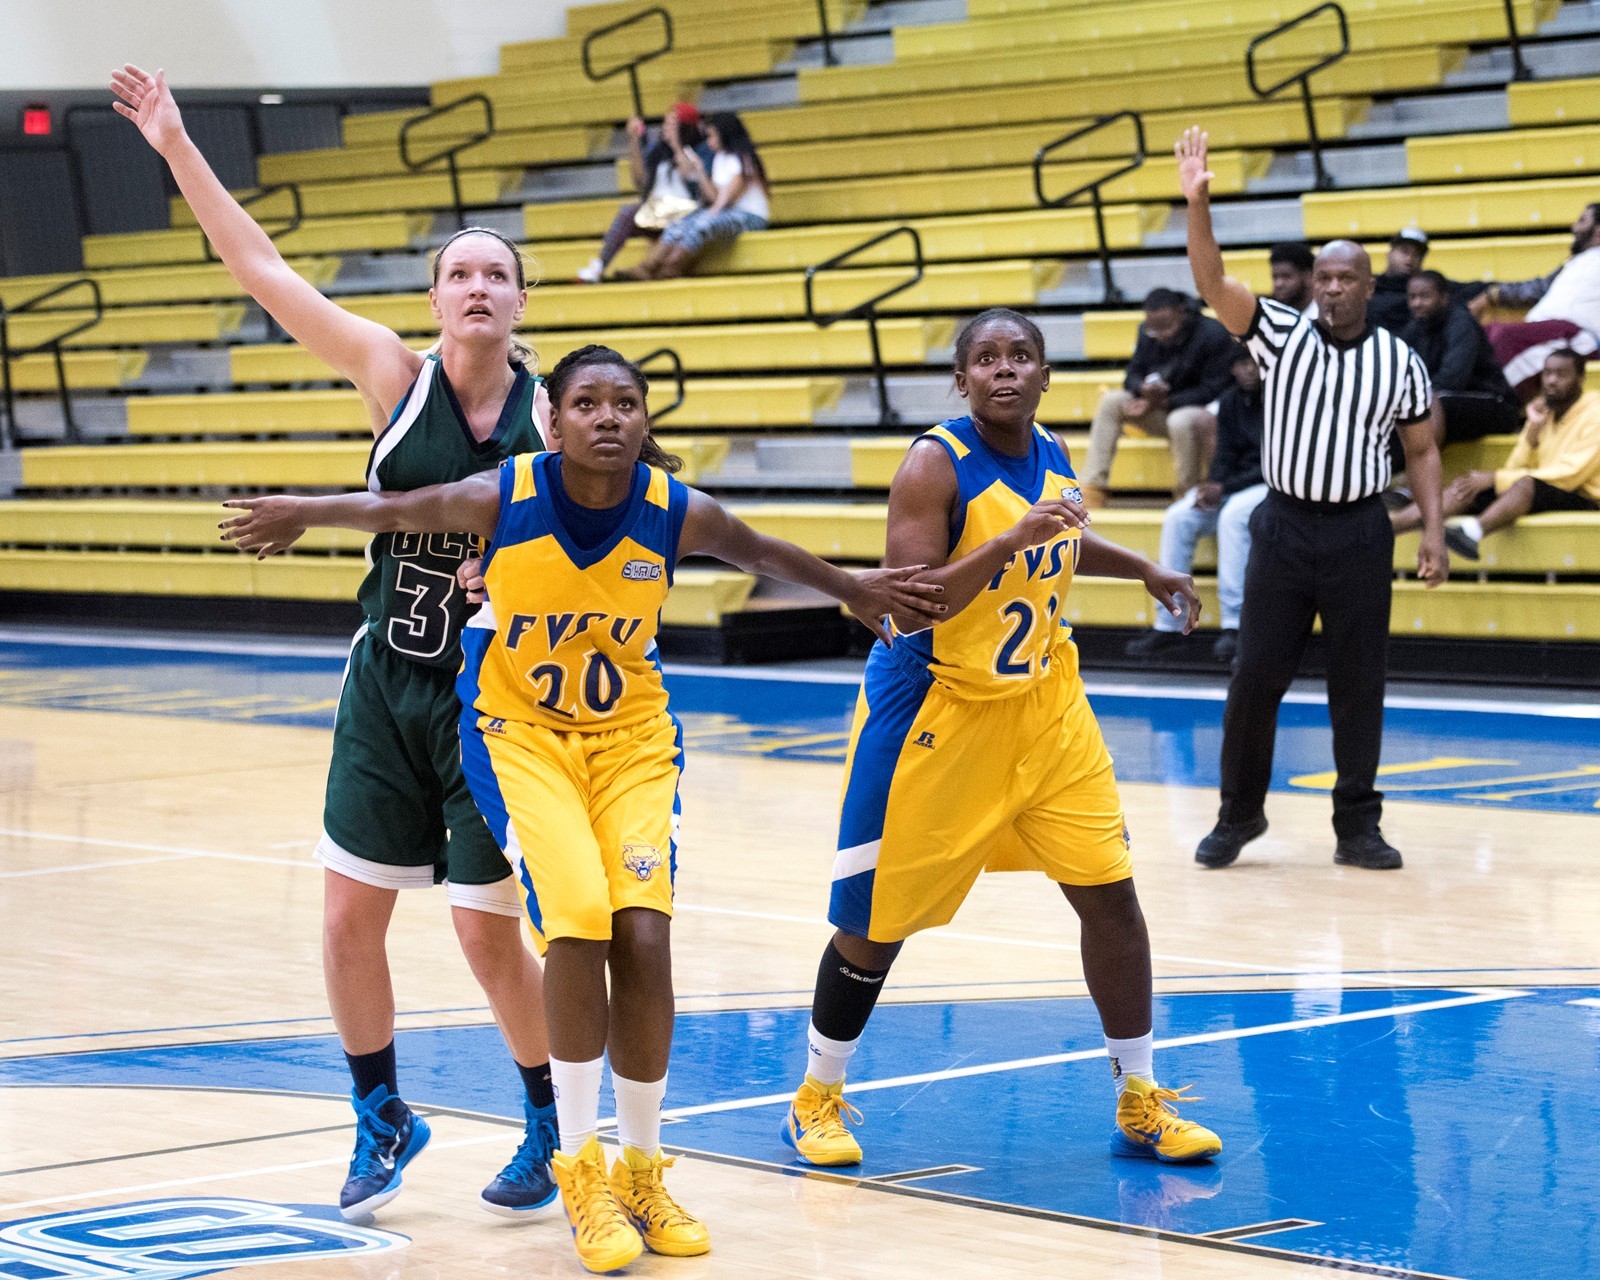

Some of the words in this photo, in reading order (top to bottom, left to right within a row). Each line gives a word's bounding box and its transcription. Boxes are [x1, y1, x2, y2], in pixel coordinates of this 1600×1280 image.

[387, 561, 456, 658] 3
[505, 612, 646, 655] FVSU
[525, 648, 627, 721] 20
